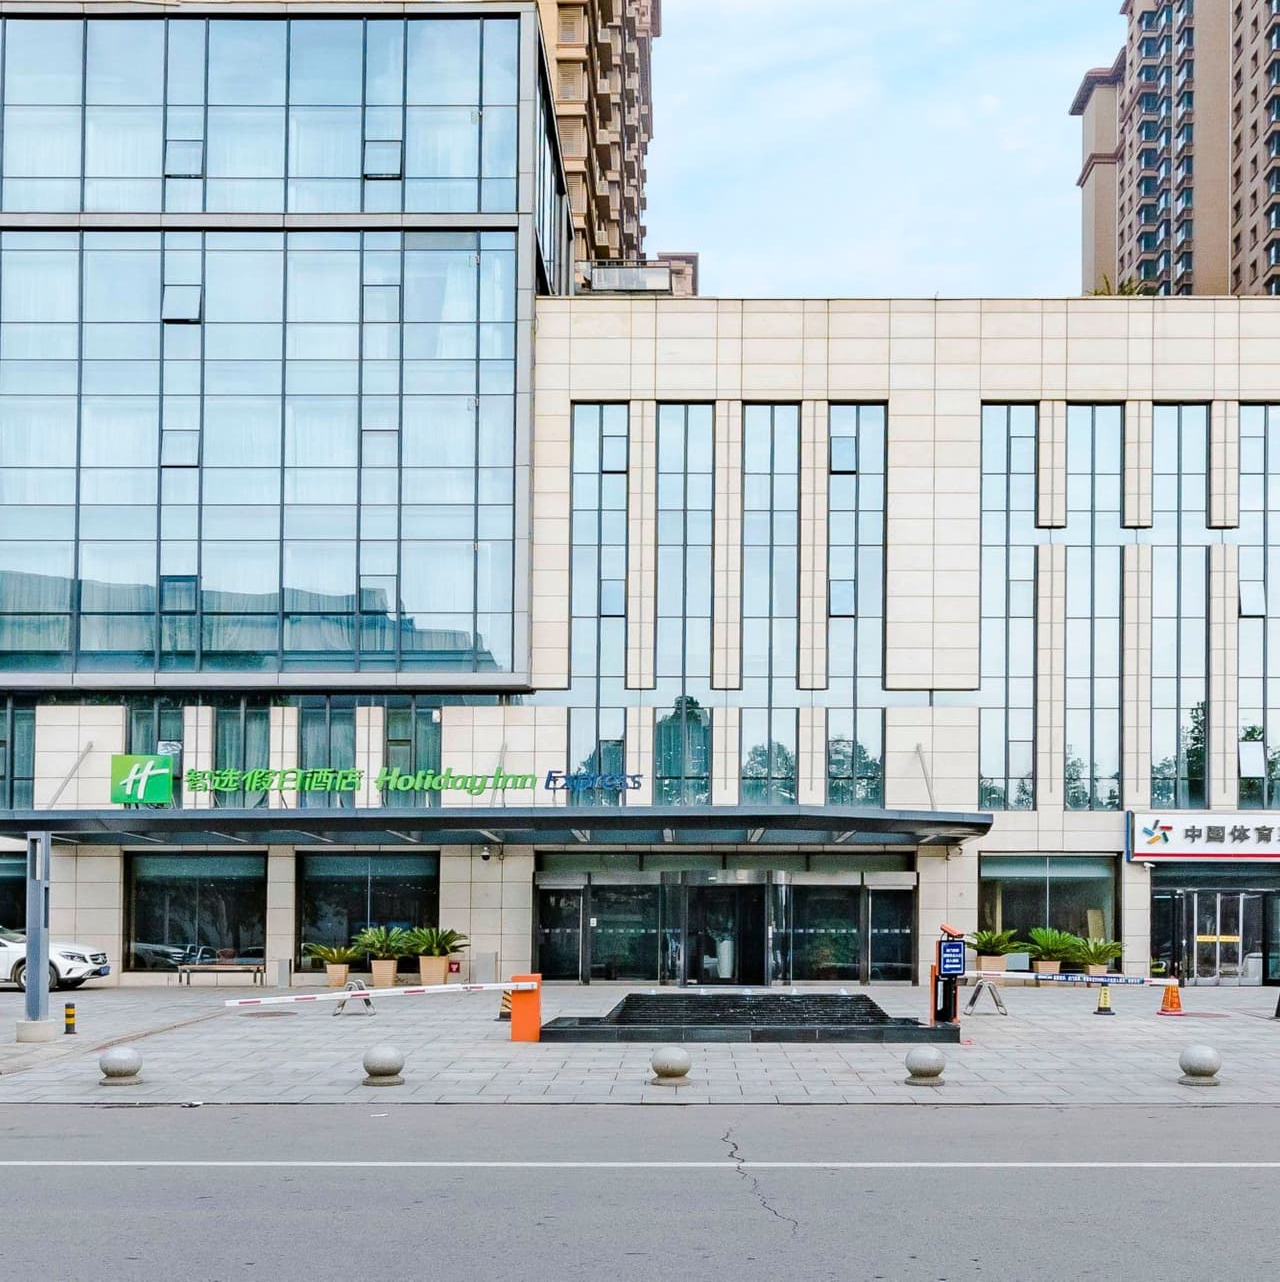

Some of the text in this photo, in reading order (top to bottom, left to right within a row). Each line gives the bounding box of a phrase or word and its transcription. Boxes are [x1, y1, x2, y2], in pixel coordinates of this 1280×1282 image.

[185, 767, 364, 792] 智选假日酒店
[374, 766, 643, 796] Holiday Inn Express
